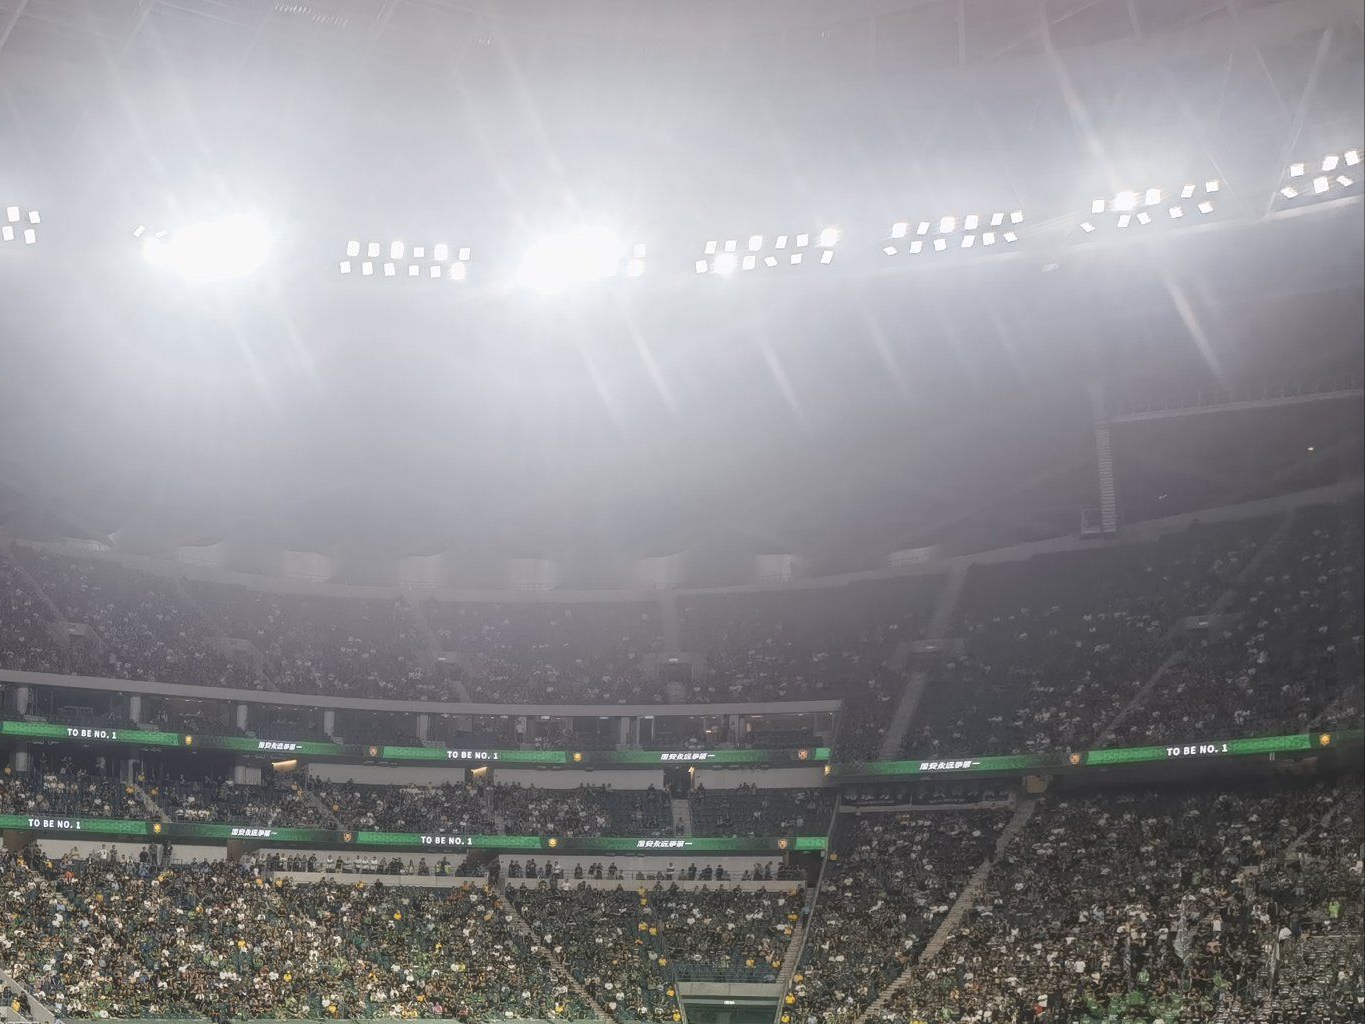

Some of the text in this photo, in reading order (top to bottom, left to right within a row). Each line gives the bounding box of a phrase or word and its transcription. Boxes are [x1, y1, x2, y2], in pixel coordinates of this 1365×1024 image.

[67, 728, 79, 736] TO
[94, 731, 110, 739] NO.
[1166, 747, 1180, 756] TO
[1183, 746, 1196, 755] BE
[1199, 744, 1219, 754] NO.
[446, 751, 459, 759] TO
[461, 751, 472, 759] BE
[474, 752, 491, 760] NO.
[28, 819, 41, 827] TO
[43, 820, 55, 828] BE
[57, 820, 74, 829] NO.
[420, 836, 432, 844] TO
[435, 836, 446, 844] BE
[449, 837, 465, 845] NO.
